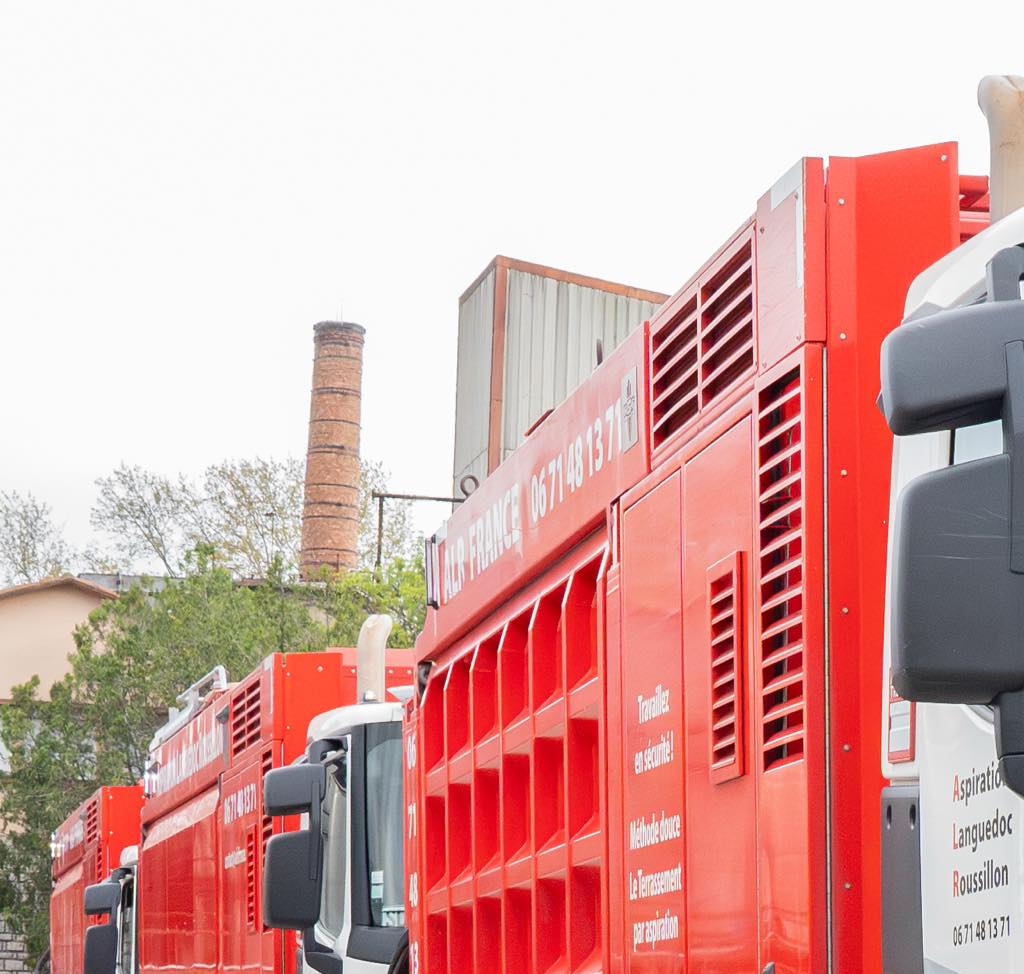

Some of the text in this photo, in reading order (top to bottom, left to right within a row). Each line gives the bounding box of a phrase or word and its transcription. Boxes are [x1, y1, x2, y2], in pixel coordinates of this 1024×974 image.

[443, 398, 622, 605] ALR FRANCE 06 71 48 13 71
[637, 683, 671, 725] Travaillez
[406, 735, 417, 770] 06
[634, 750, 644, 775] en
[953, 760, 1005, 807] Aspiratio
[408, 802, 417, 839] 71
[629, 810, 681, 850] Méthode douce
[953, 808, 1013, 853] Languedoc
[409, 871, 418, 908] 48
[629, 861, 682, 901] Le Terrassement
[953, 860, 1009, 898] Roussillon
[633, 907, 679, 953] par aspiration
[953, 915, 1011, 947] 06 71 48 13 71
